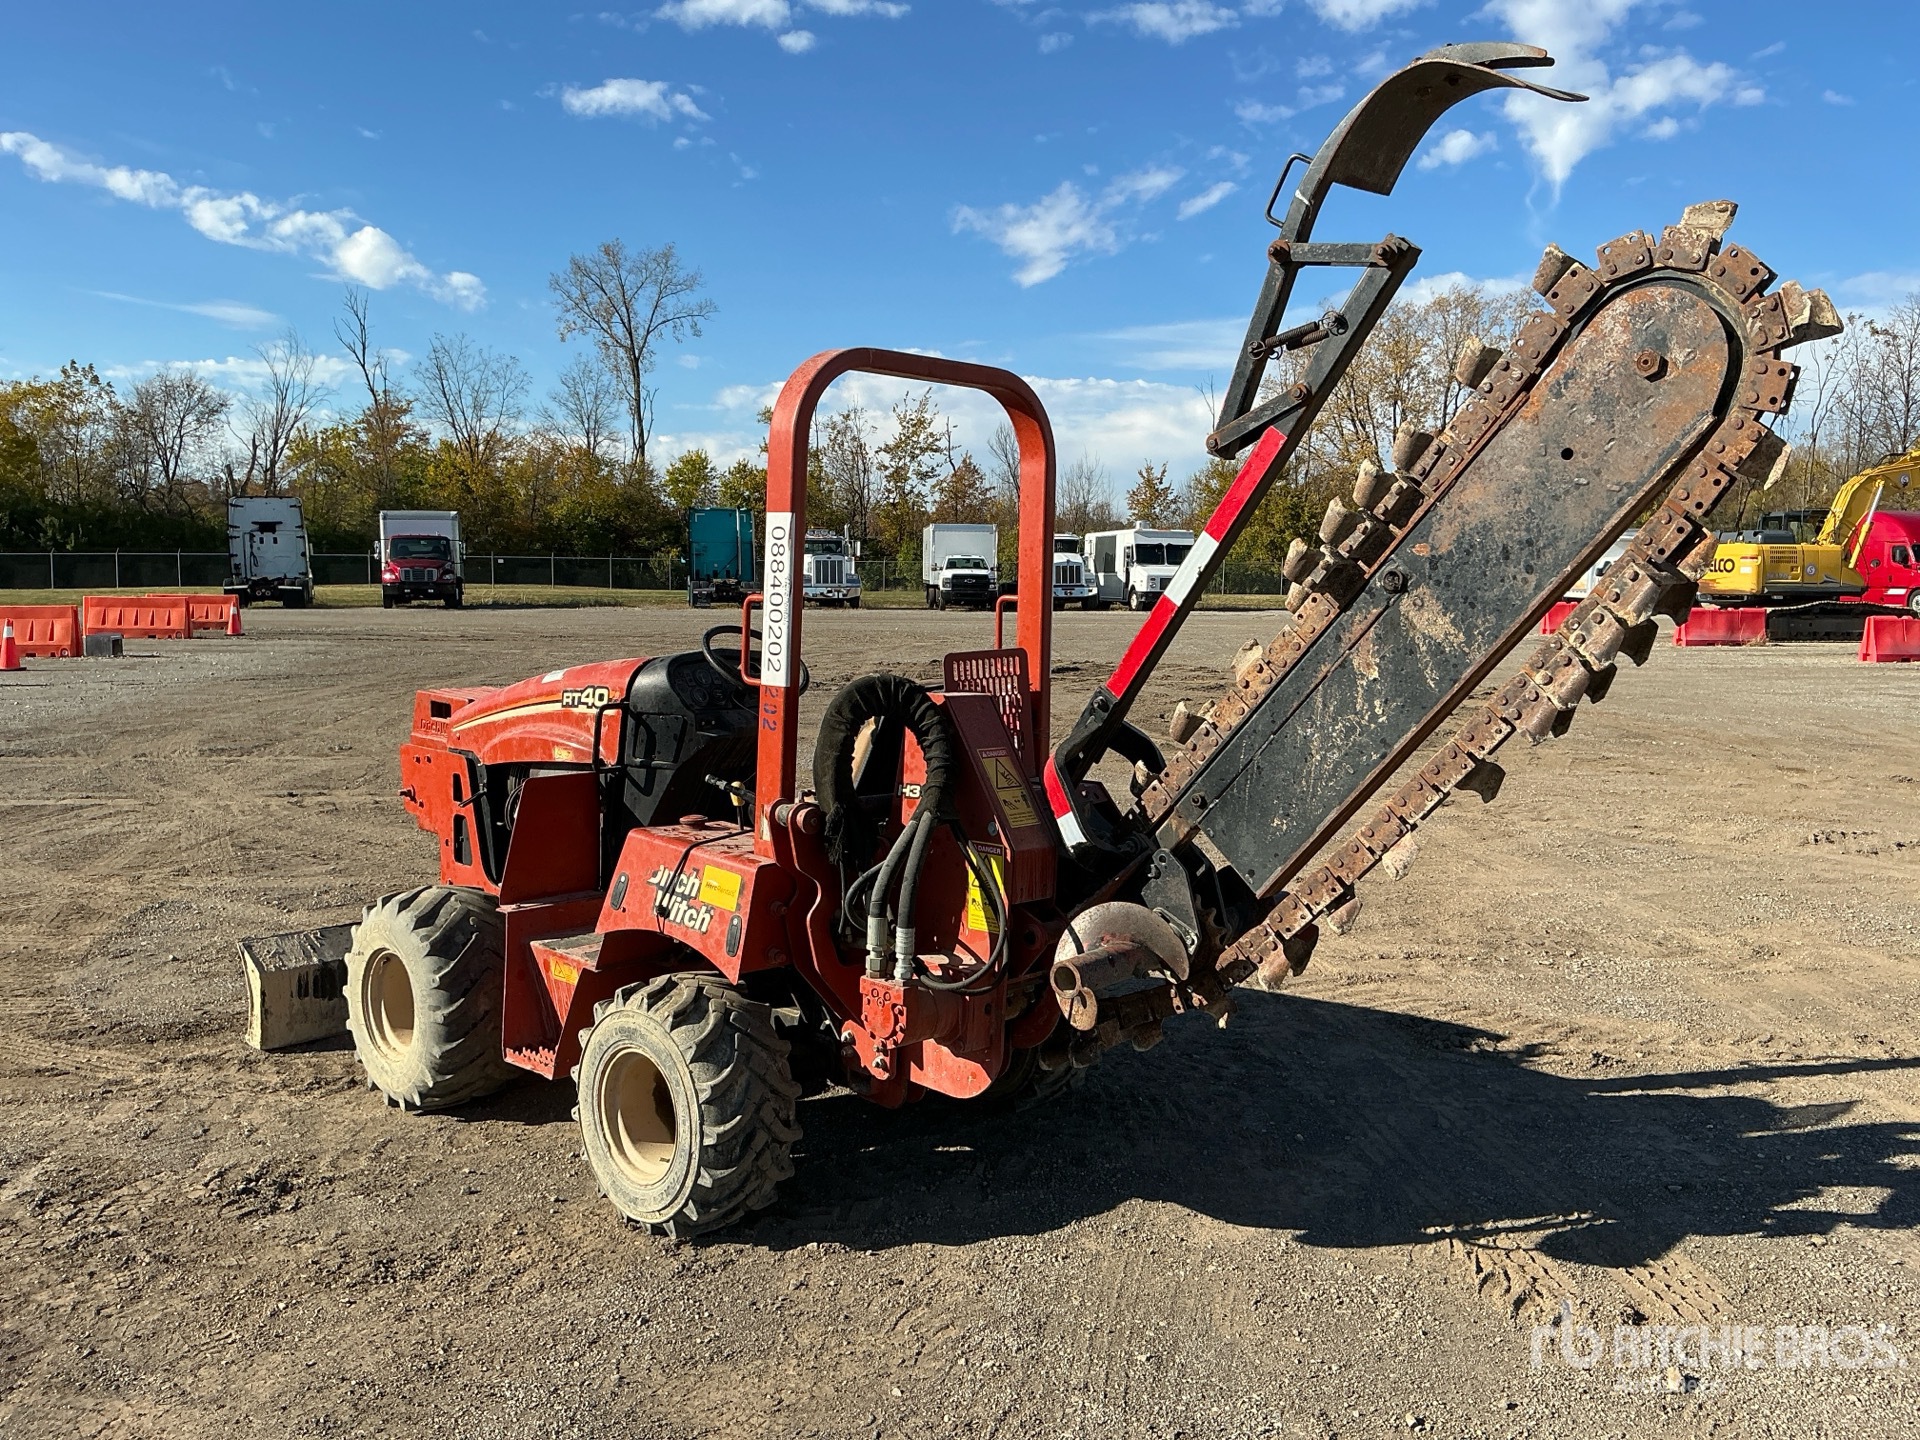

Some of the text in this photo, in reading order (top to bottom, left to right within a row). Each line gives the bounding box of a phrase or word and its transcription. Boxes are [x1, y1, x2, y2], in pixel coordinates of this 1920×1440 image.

[767, 526, 787, 672] 088400202
[562, 687, 609, 708] RT40
[977, 844, 1001, 855] DANGER
[653, 889, 712, 934] Witch
